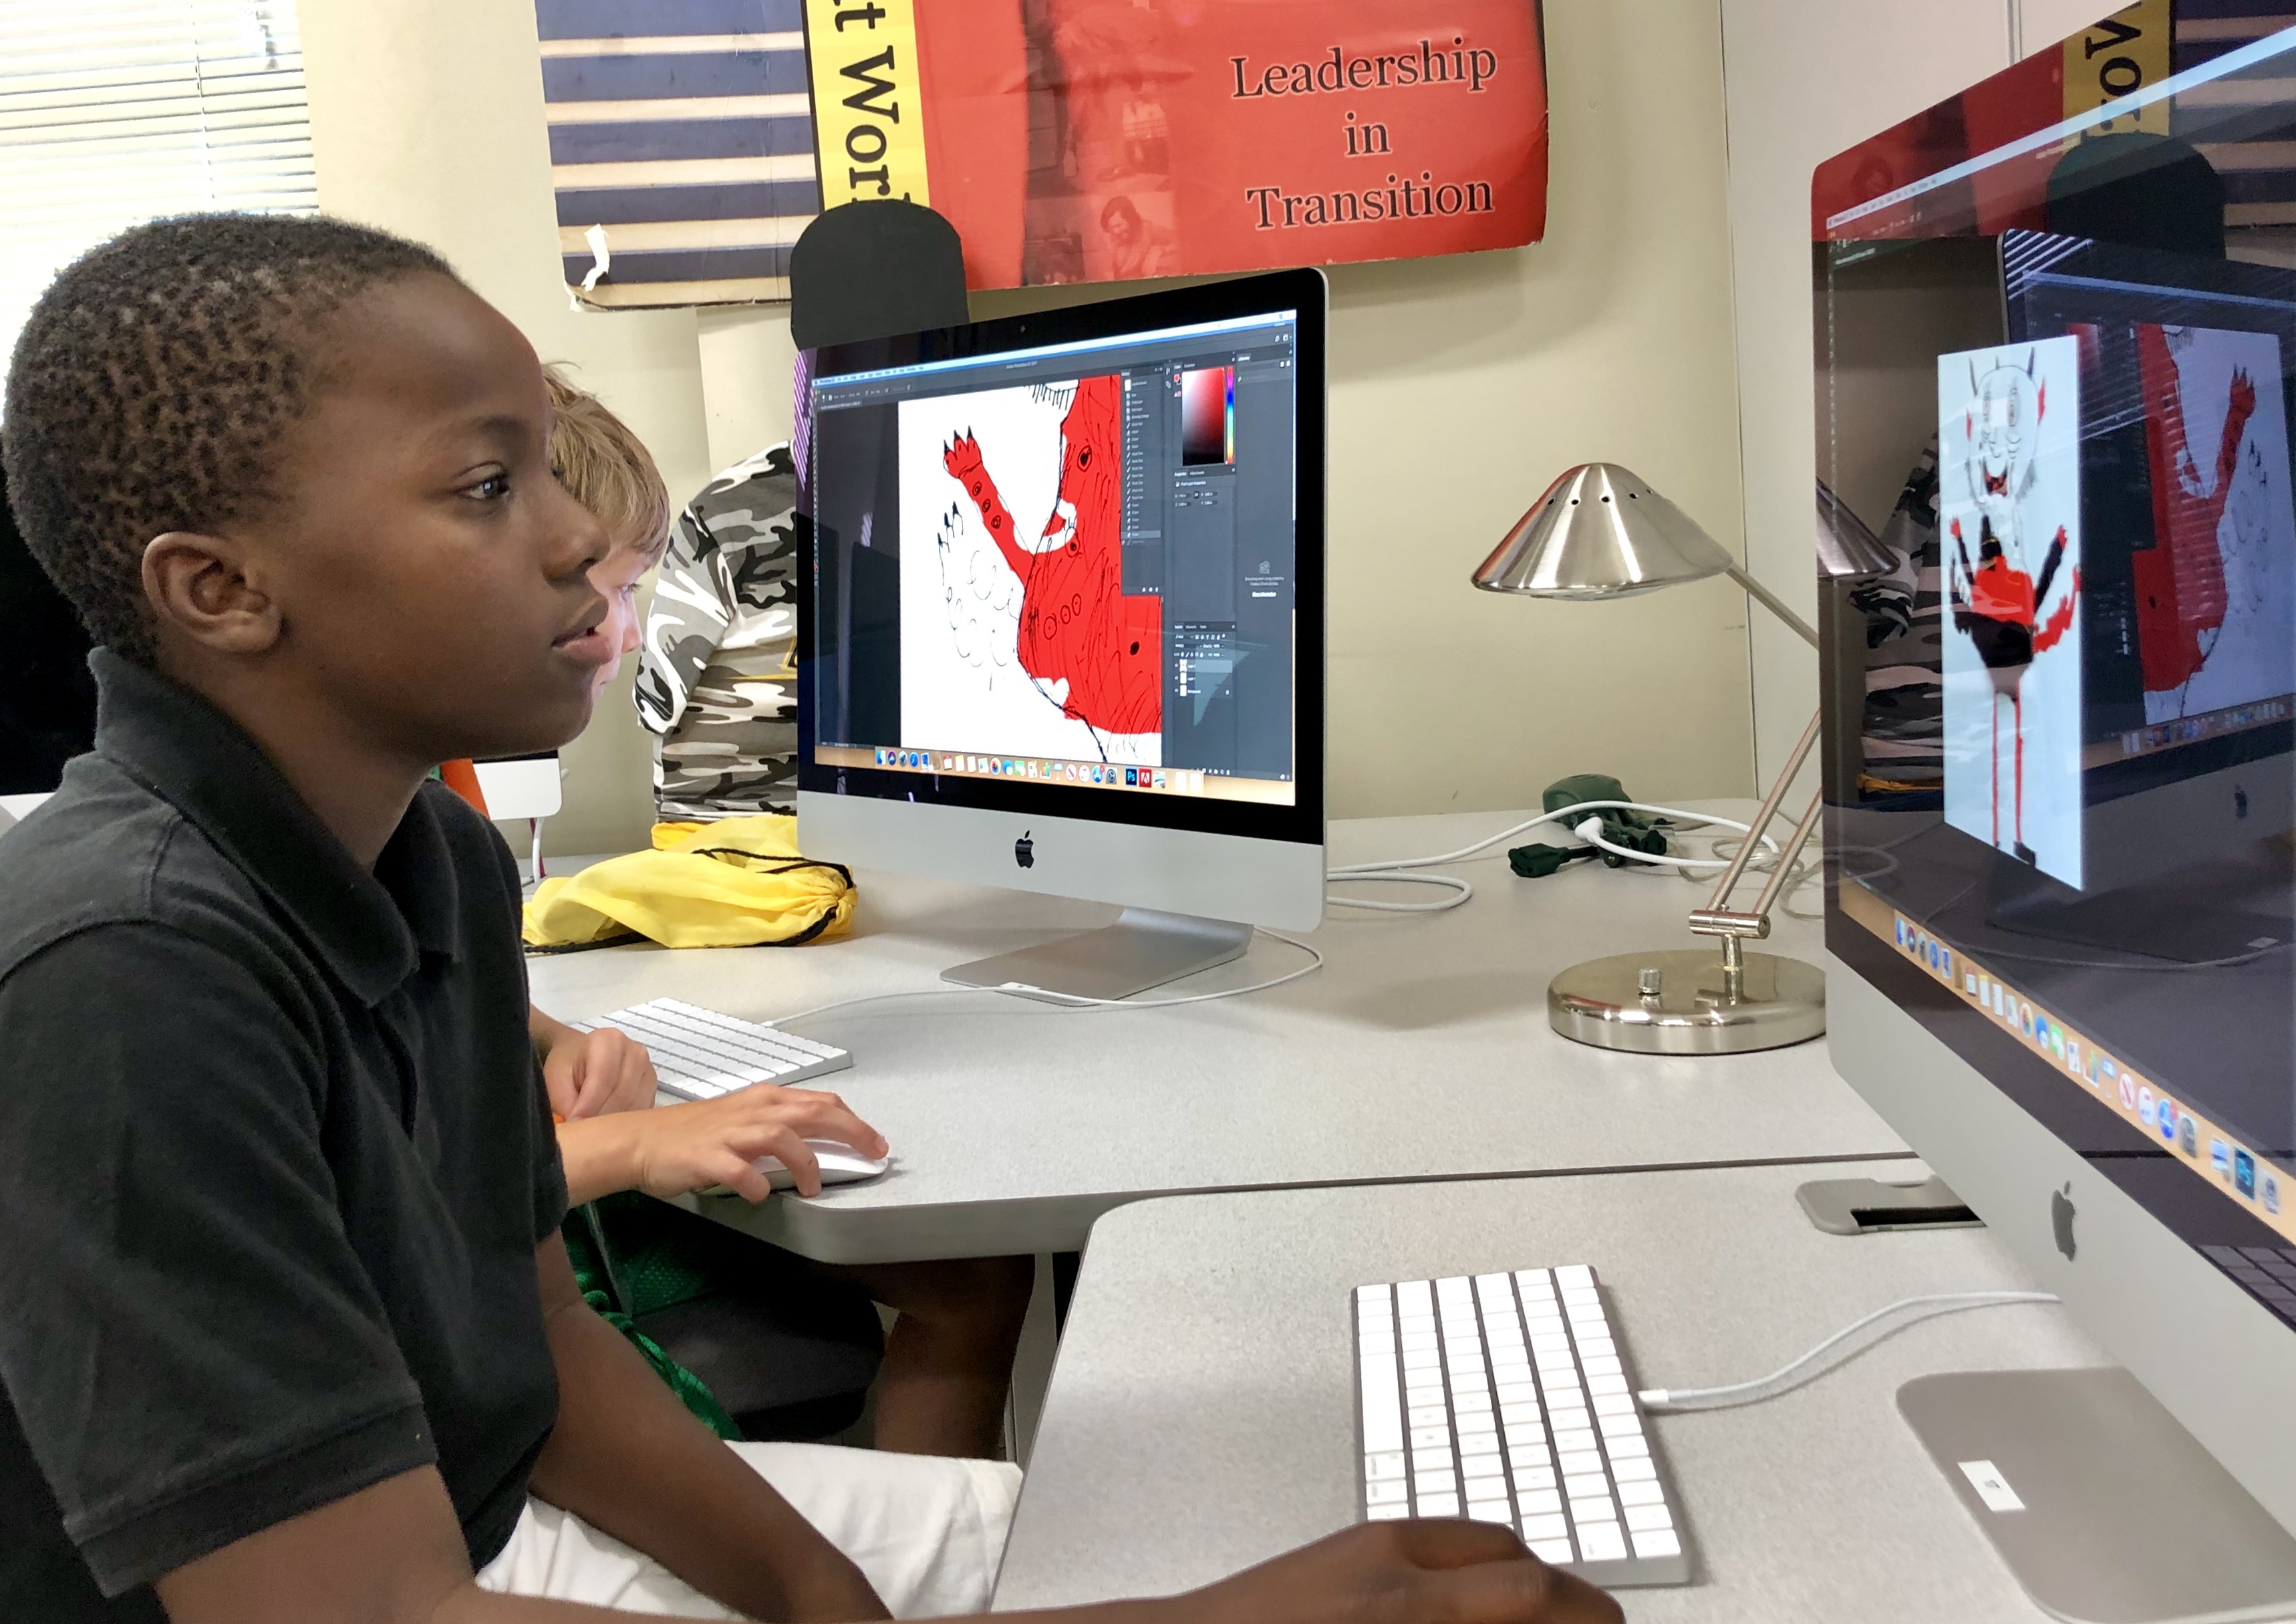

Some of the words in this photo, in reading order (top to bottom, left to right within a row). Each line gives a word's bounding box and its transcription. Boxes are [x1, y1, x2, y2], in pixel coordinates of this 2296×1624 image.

[833, 0, 886, 32] t
[1231, 36, 1497, 98] Leadership
[839, 45, 911, 202] Wor
[1344, 112, 1392, 156] in
[1246, 171, 1493, 229] Transition
[1127, 771, 1136, 782] Ps
